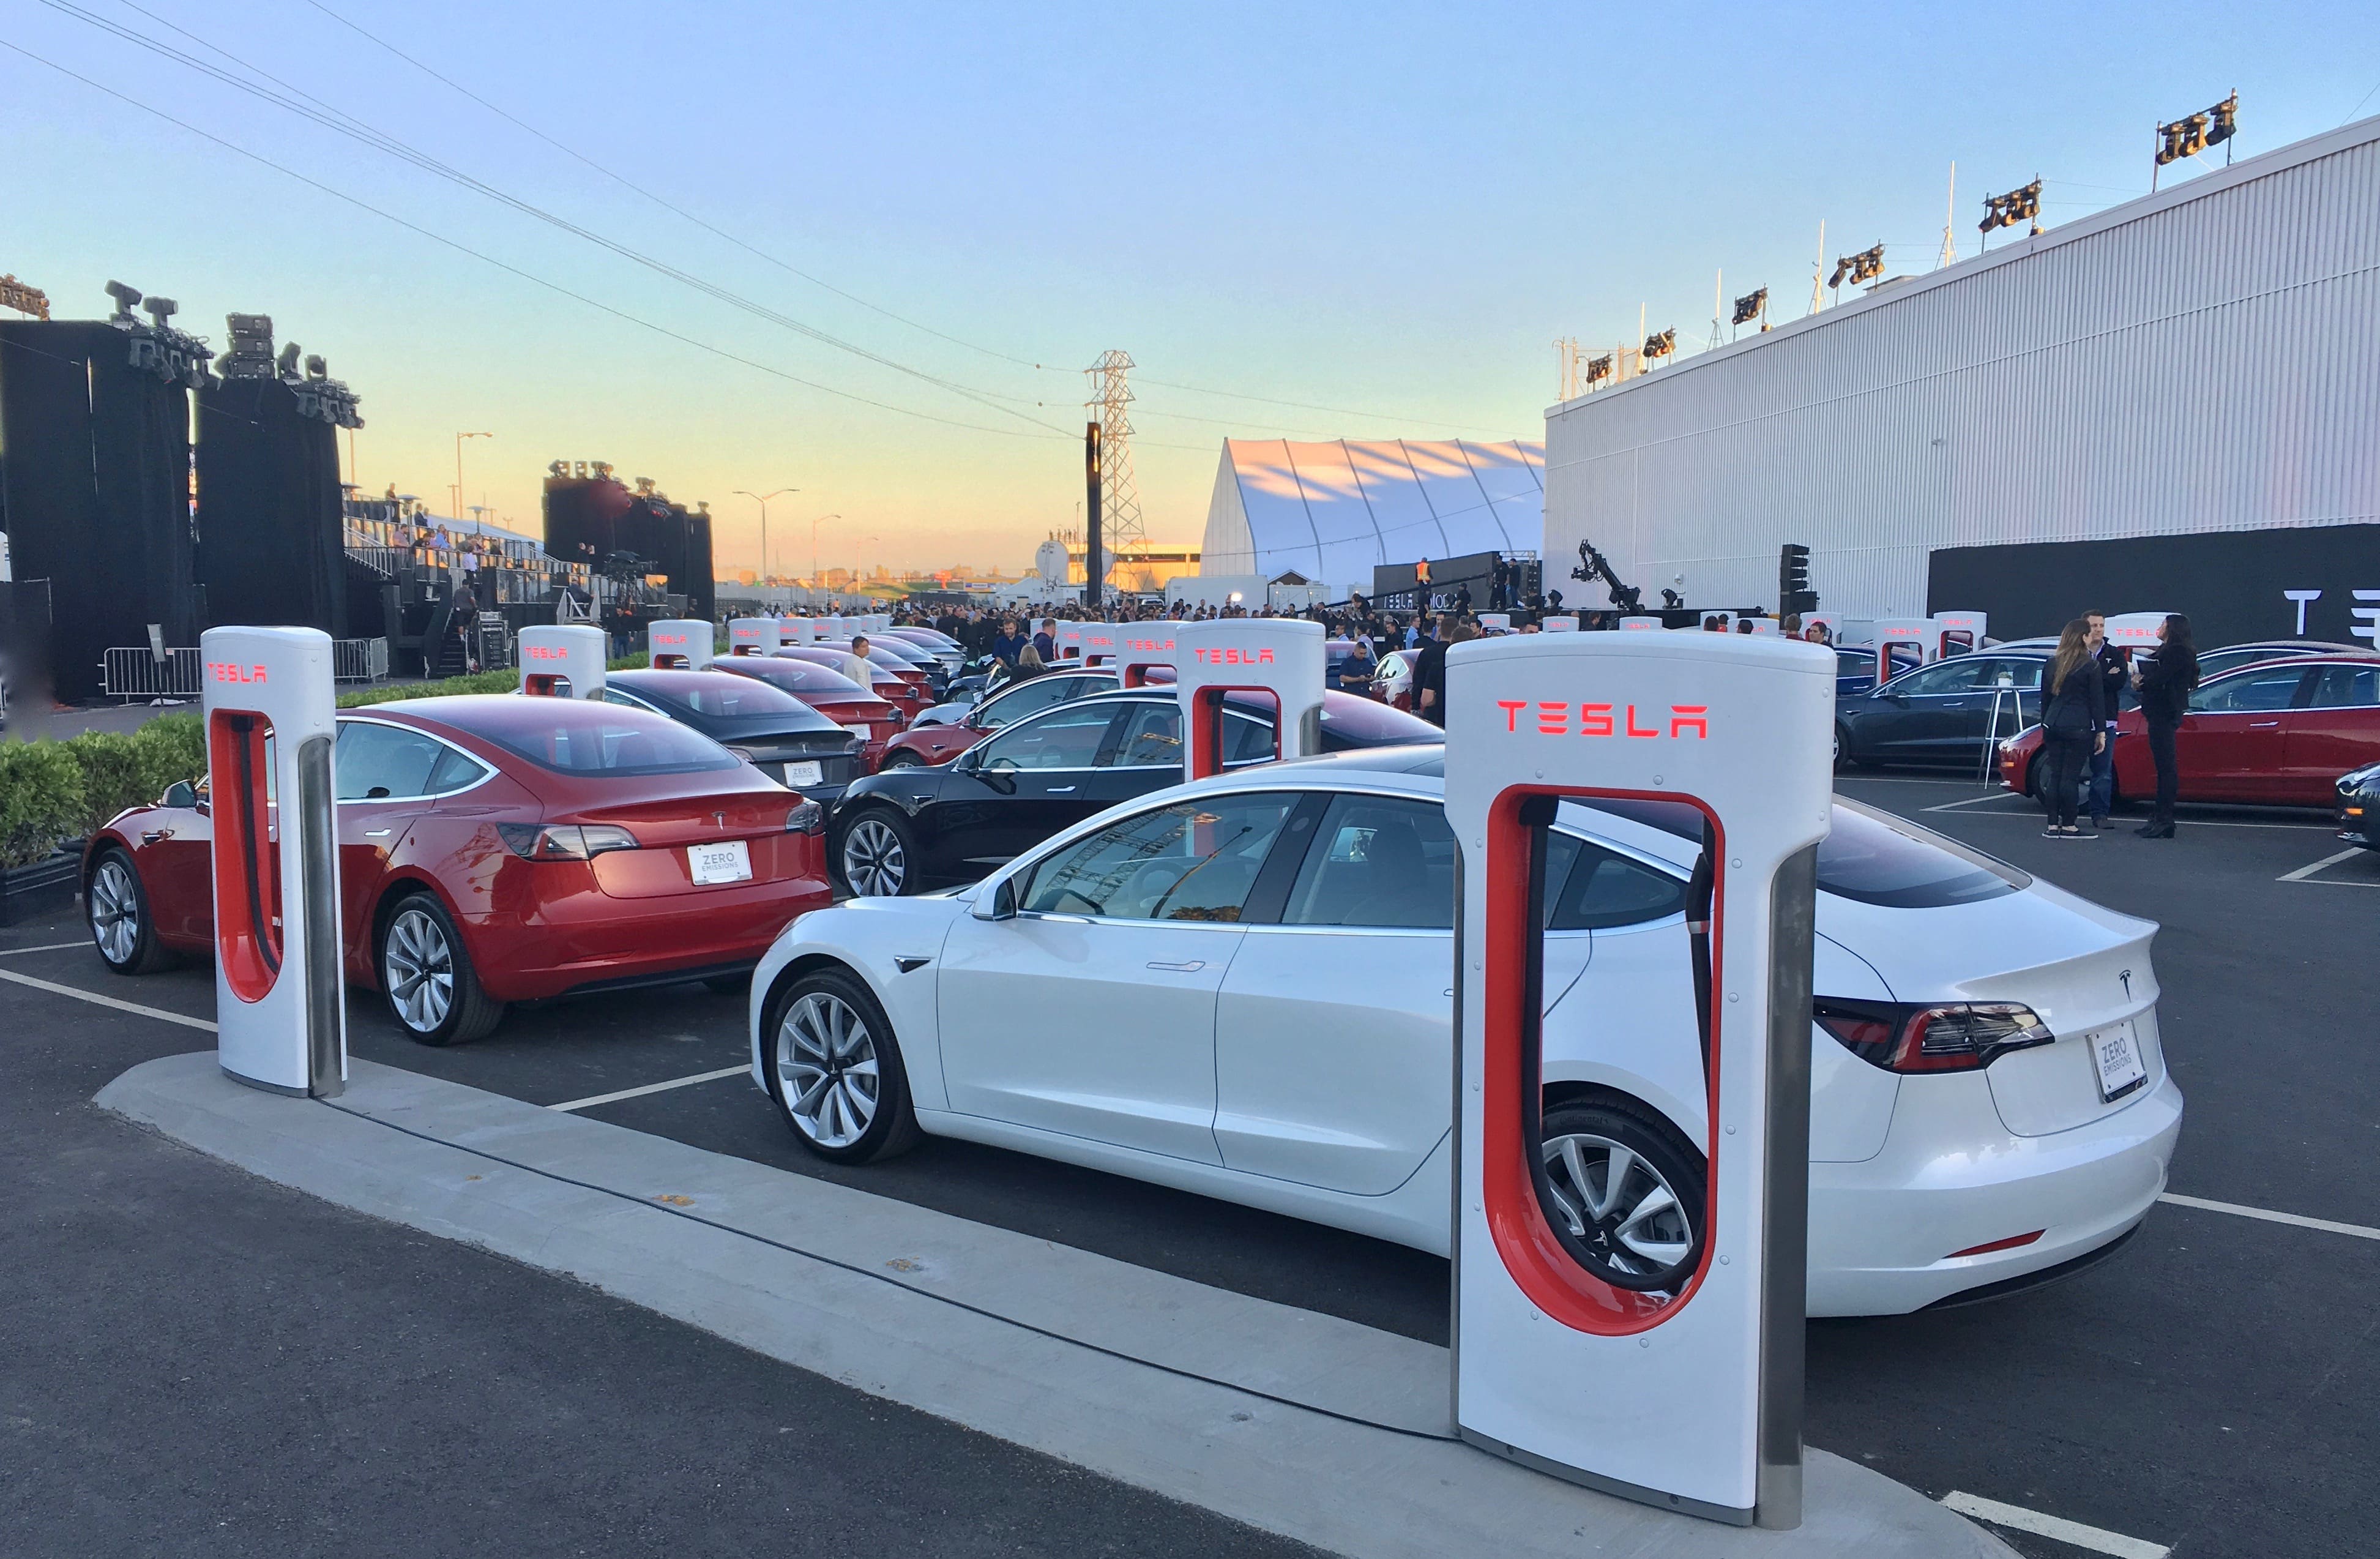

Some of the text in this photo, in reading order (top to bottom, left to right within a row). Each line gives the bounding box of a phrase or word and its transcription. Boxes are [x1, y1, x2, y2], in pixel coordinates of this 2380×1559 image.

[654, 635, 686, 643] TESLA
[1087, 637, 1114, 646] TESL
[1127, 640, 1174, 651] TESLA
[524, 646, 567, 659] TESLA
[1195, 649, 1274, 664] TESLA
[207, 663, 266, 683] TESLA
[1497, 700, 1708, 739] TESLA
[703, 853, 734, 865] ZERO
[702, 862, 738, 871] EMISSIONS
[2102, 1037, 2127, 1064] ZERO
[2103, 1053, 2132, 1076] EMISSIONS
